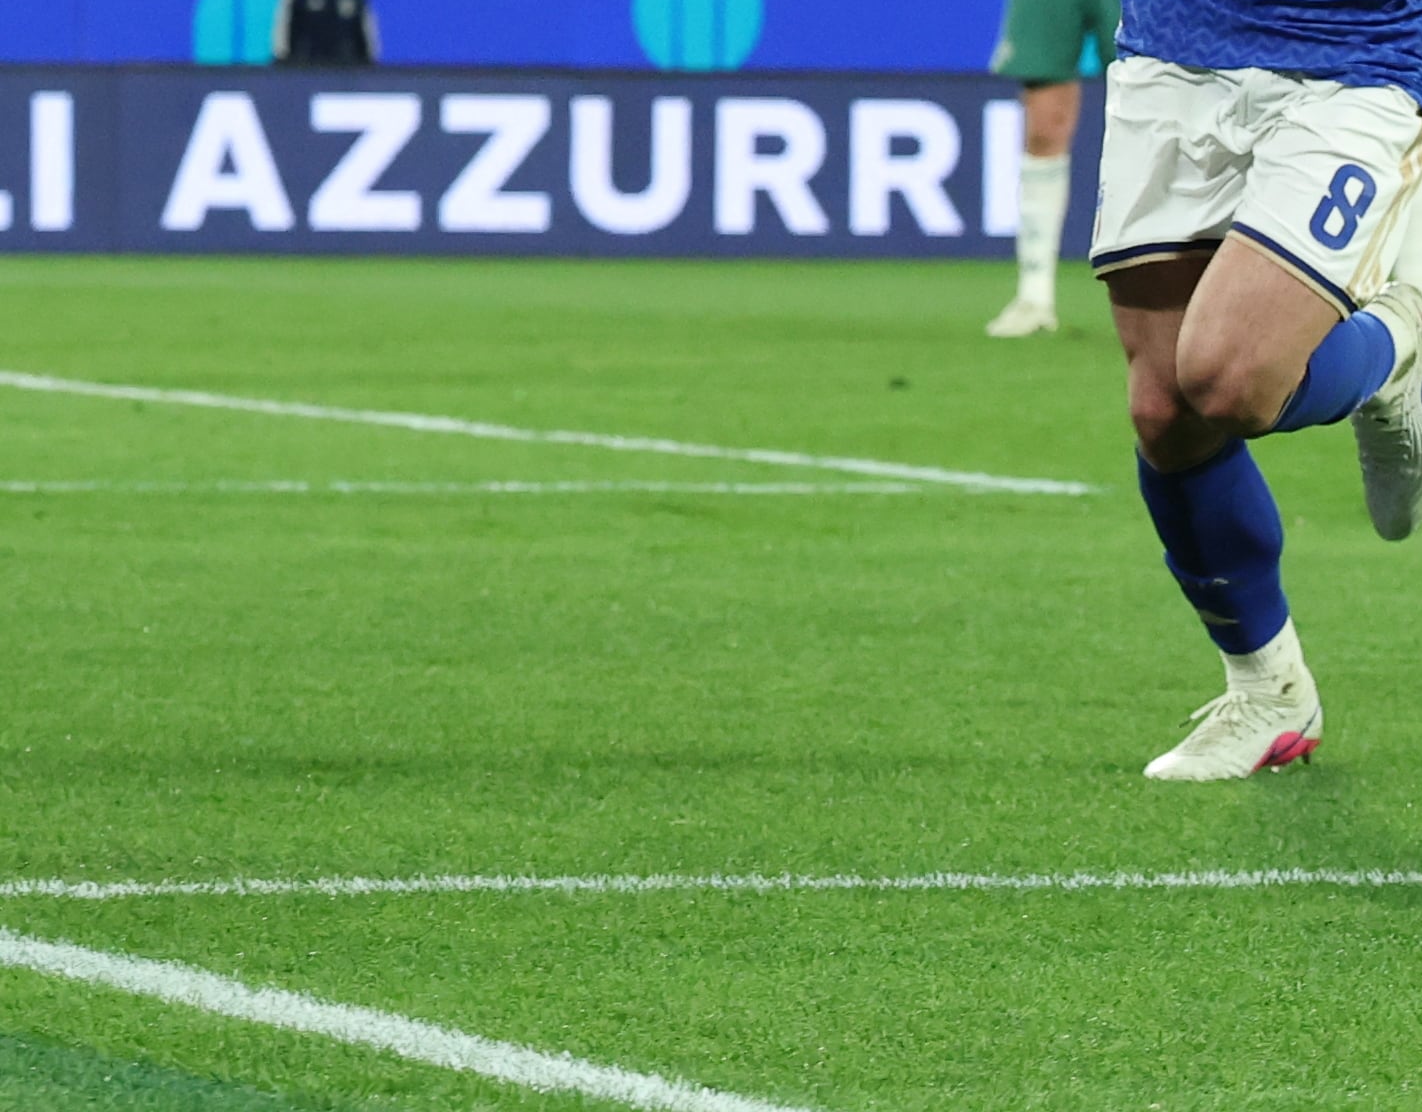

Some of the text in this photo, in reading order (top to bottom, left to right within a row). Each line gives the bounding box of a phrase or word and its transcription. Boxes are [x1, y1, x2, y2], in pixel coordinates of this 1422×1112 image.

[0, 91, 1024, 237] I AZZURRI
[1309, 164, 1377, 251] 8
